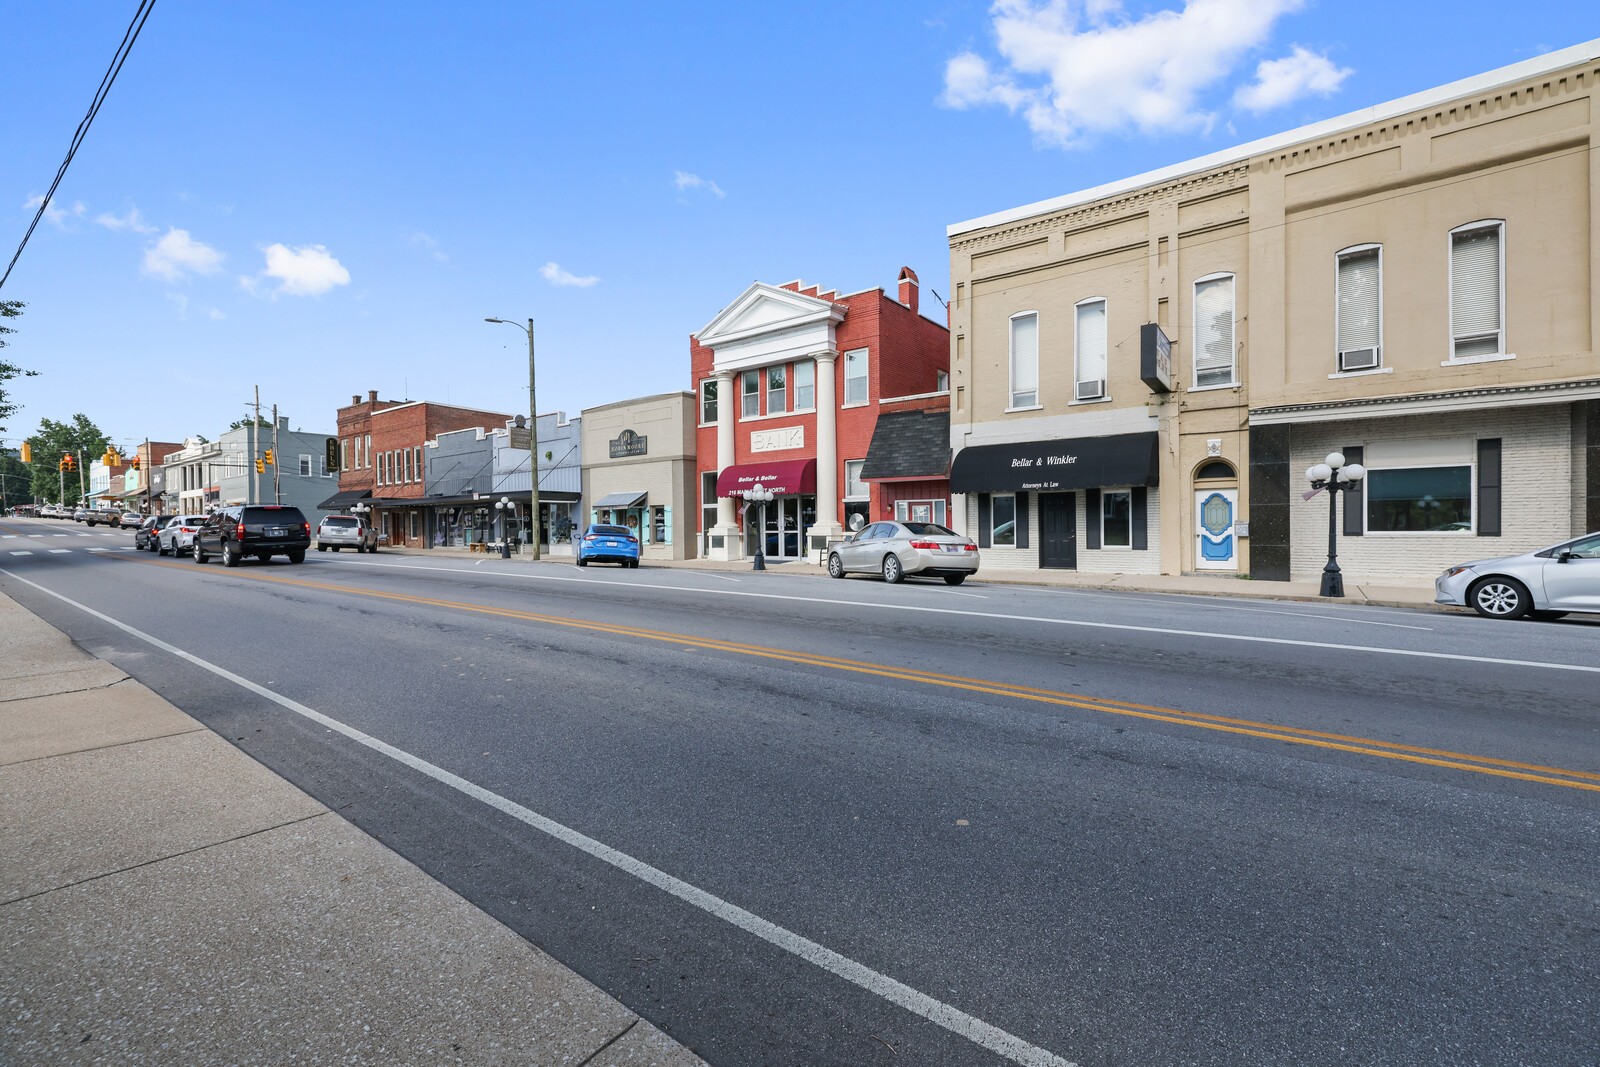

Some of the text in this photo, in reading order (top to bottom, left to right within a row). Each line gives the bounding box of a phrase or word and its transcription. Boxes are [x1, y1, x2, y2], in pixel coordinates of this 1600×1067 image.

[754, 430, 801, 449] BANK
[1011, 455, 1077, 467] Bellar & Winkler
